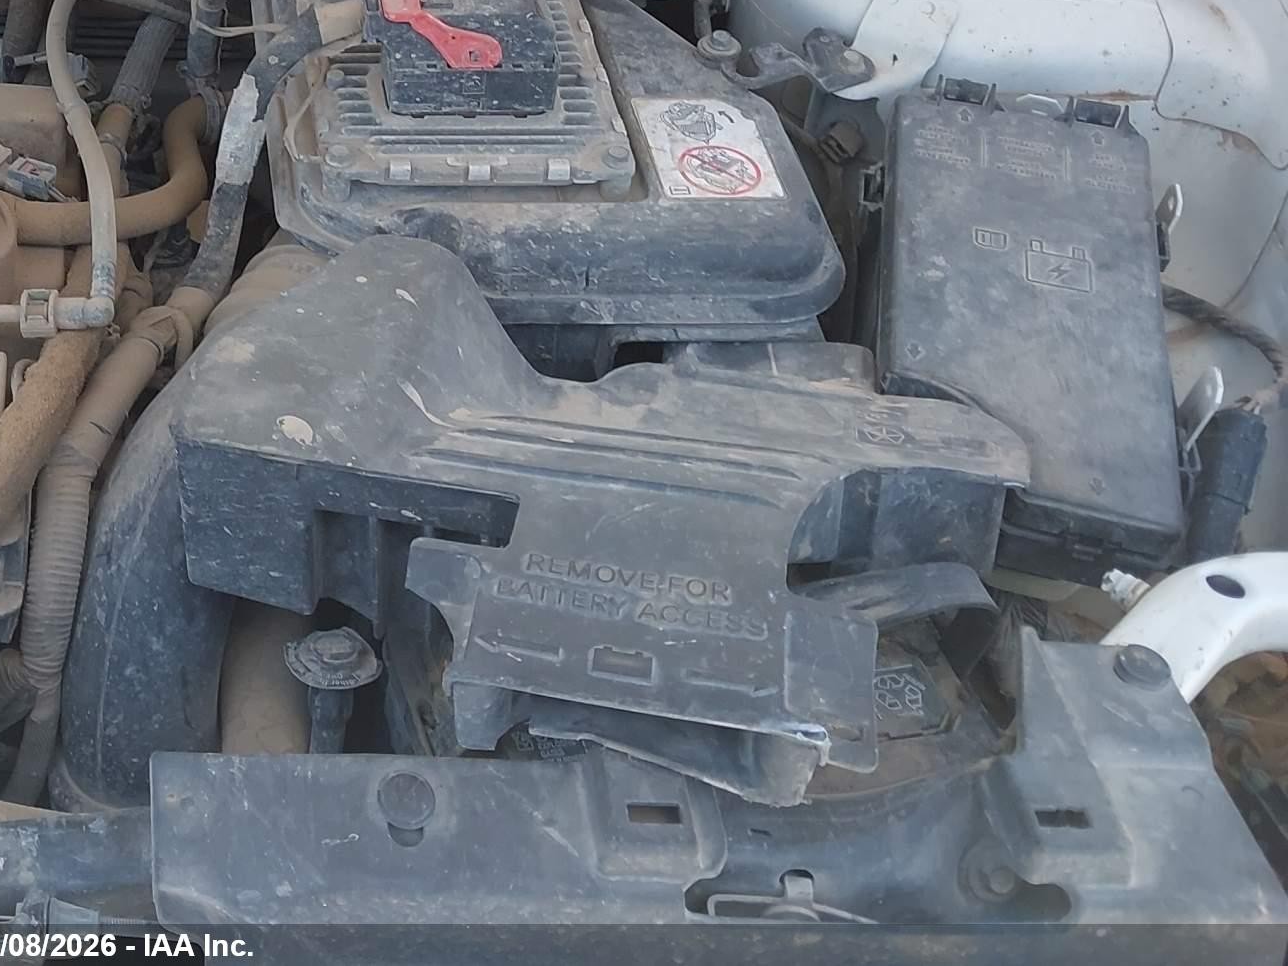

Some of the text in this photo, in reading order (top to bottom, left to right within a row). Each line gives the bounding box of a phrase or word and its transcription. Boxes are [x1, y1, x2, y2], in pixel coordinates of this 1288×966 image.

[525, 553, 730, 602] REMOVE FOR
[497, 577, 768, 639] BATTERY ACCESS
